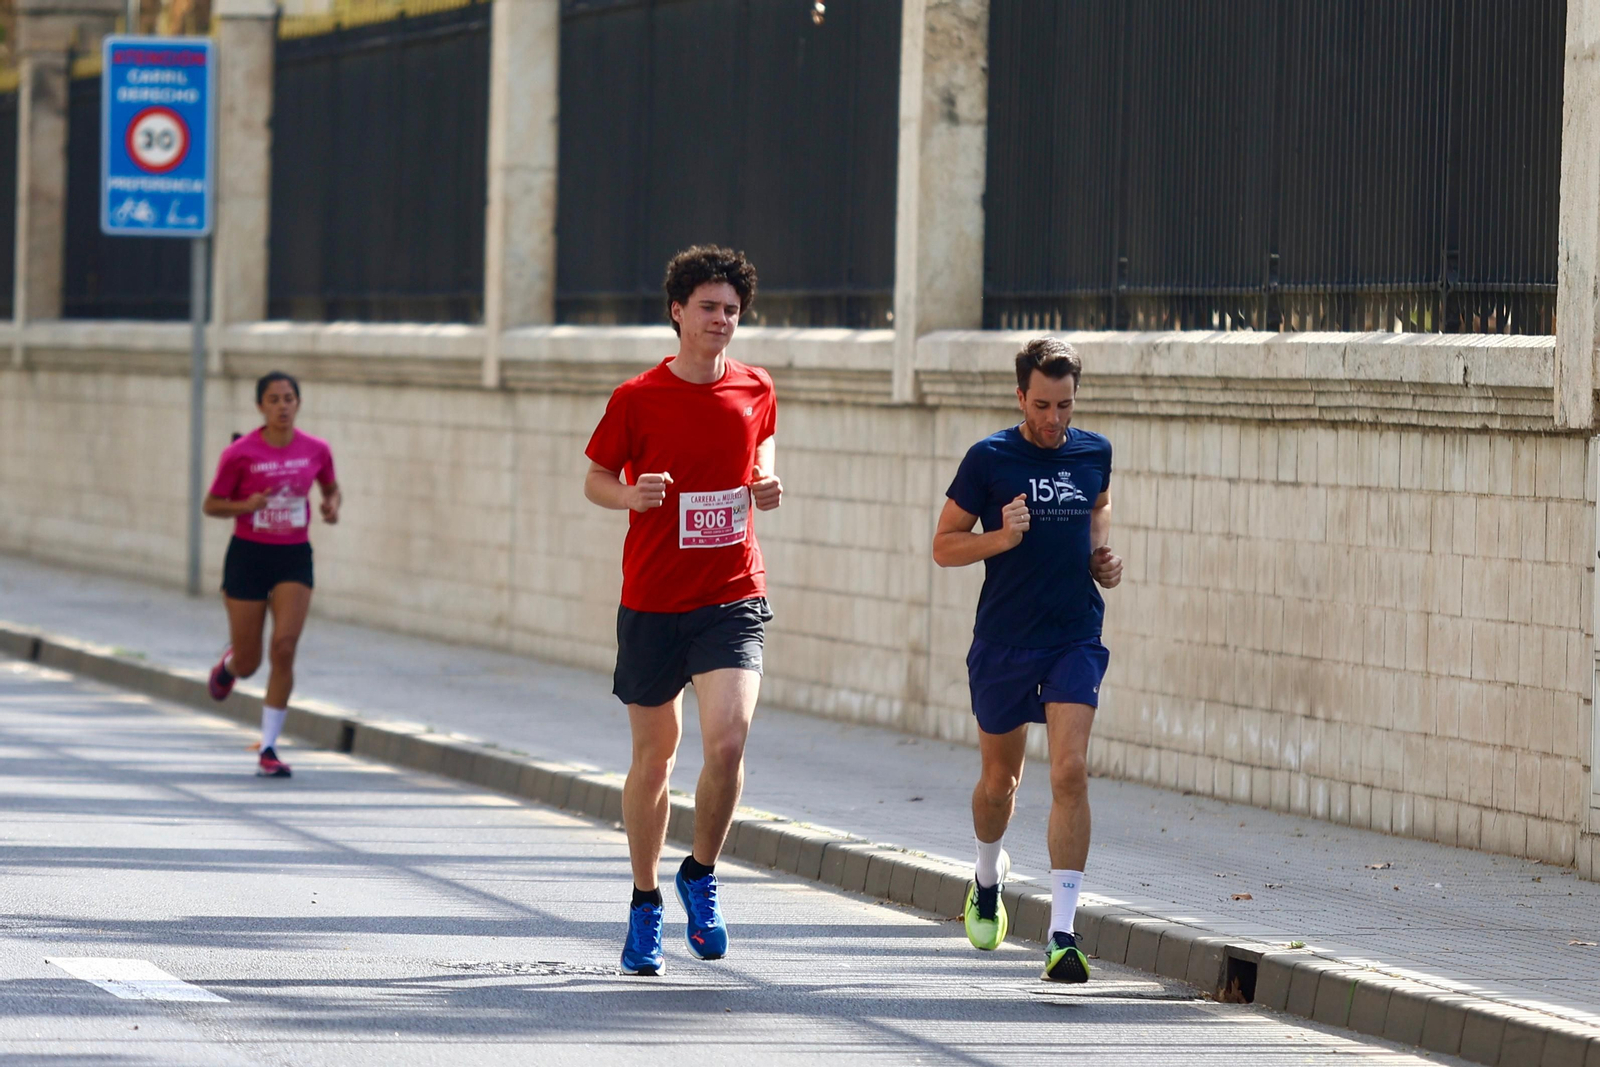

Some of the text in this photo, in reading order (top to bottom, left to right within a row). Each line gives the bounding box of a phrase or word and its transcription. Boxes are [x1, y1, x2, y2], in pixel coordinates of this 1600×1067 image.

[117, 86, 200, 103] DERECHO
[141, 131, 176, 152] 30
[690, 495, 716, 504] CARRERA
[722, 492, 743, 502] MUJERES
[693, 510, 727, 529] 906
